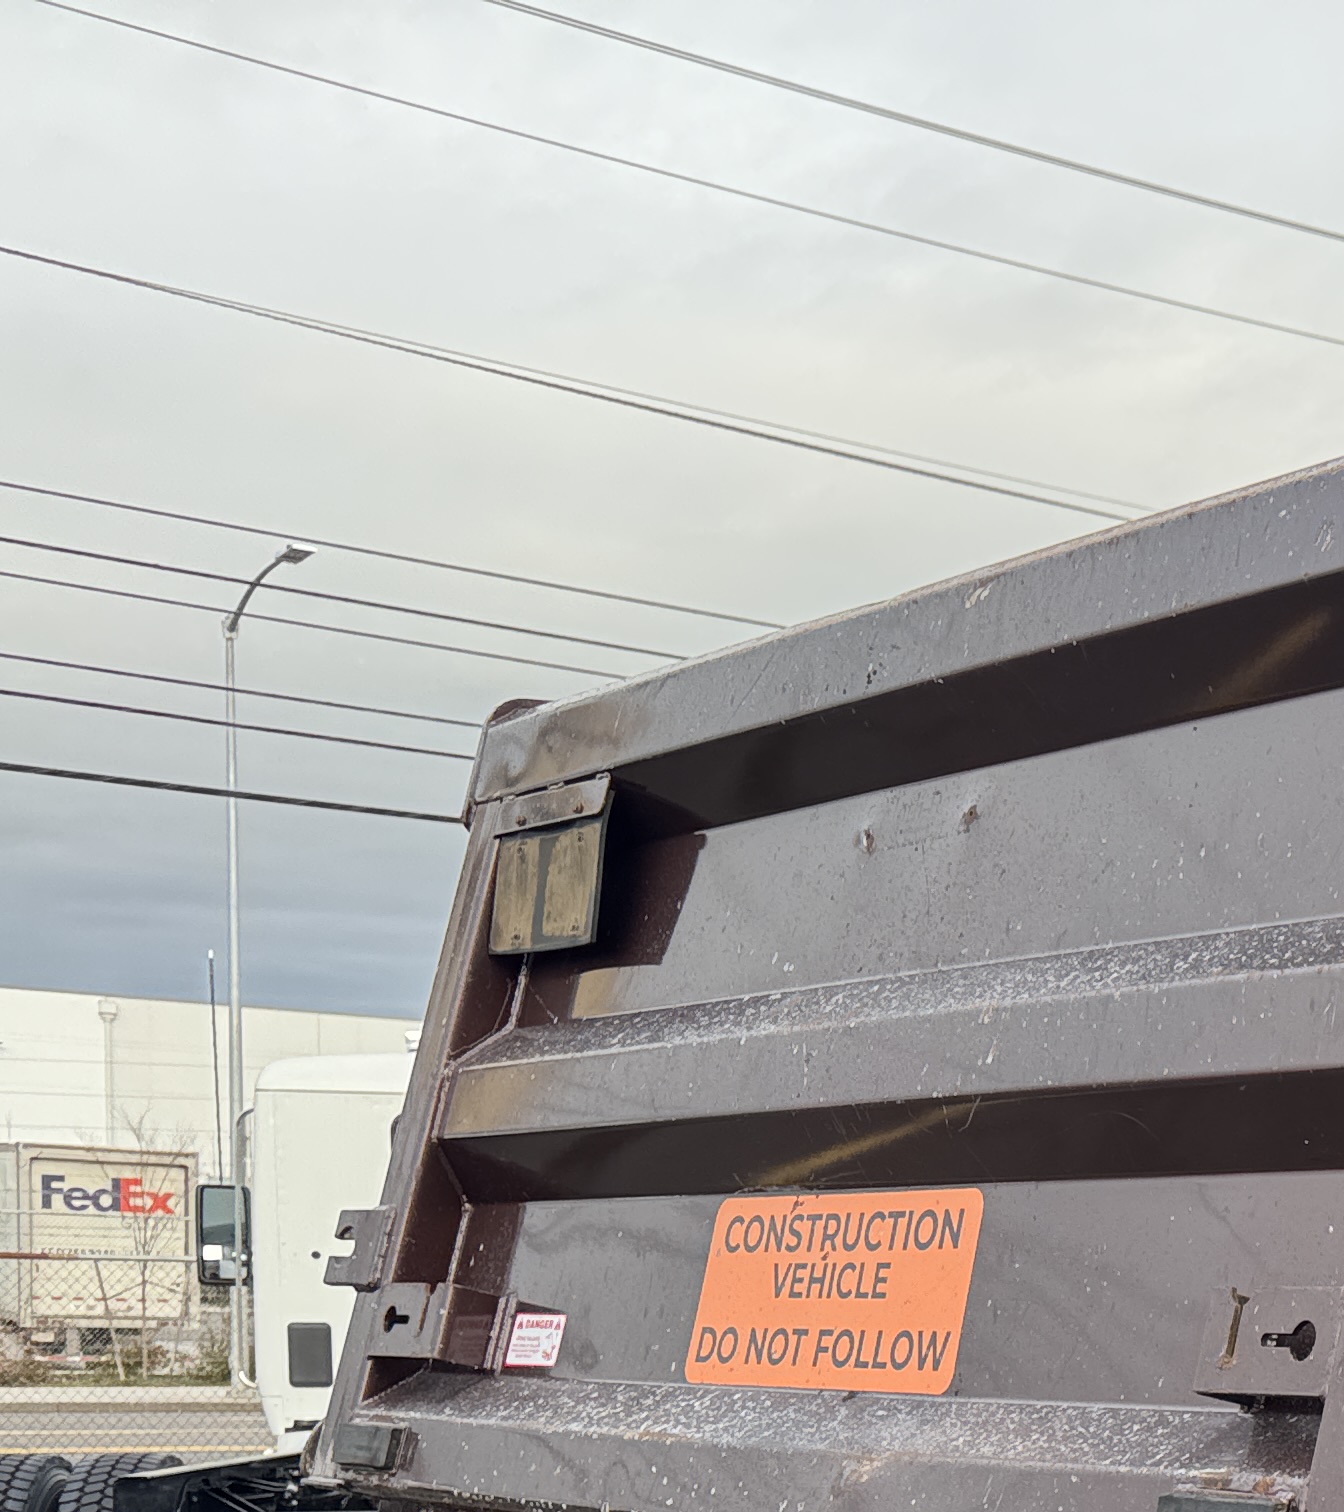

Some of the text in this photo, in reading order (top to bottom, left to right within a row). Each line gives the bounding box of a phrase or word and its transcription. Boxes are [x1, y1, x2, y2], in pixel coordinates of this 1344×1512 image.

[41, 1174, 174, 1214] FedEx
[724, 1207, 965, 1254] CONSTRUCTION
[773, 1261, 892, 1299] VEHICLE
[525, 1319, 554, 1330] DANGER
[694, 1326, 952, 1372] DO NOT FOLLOW
